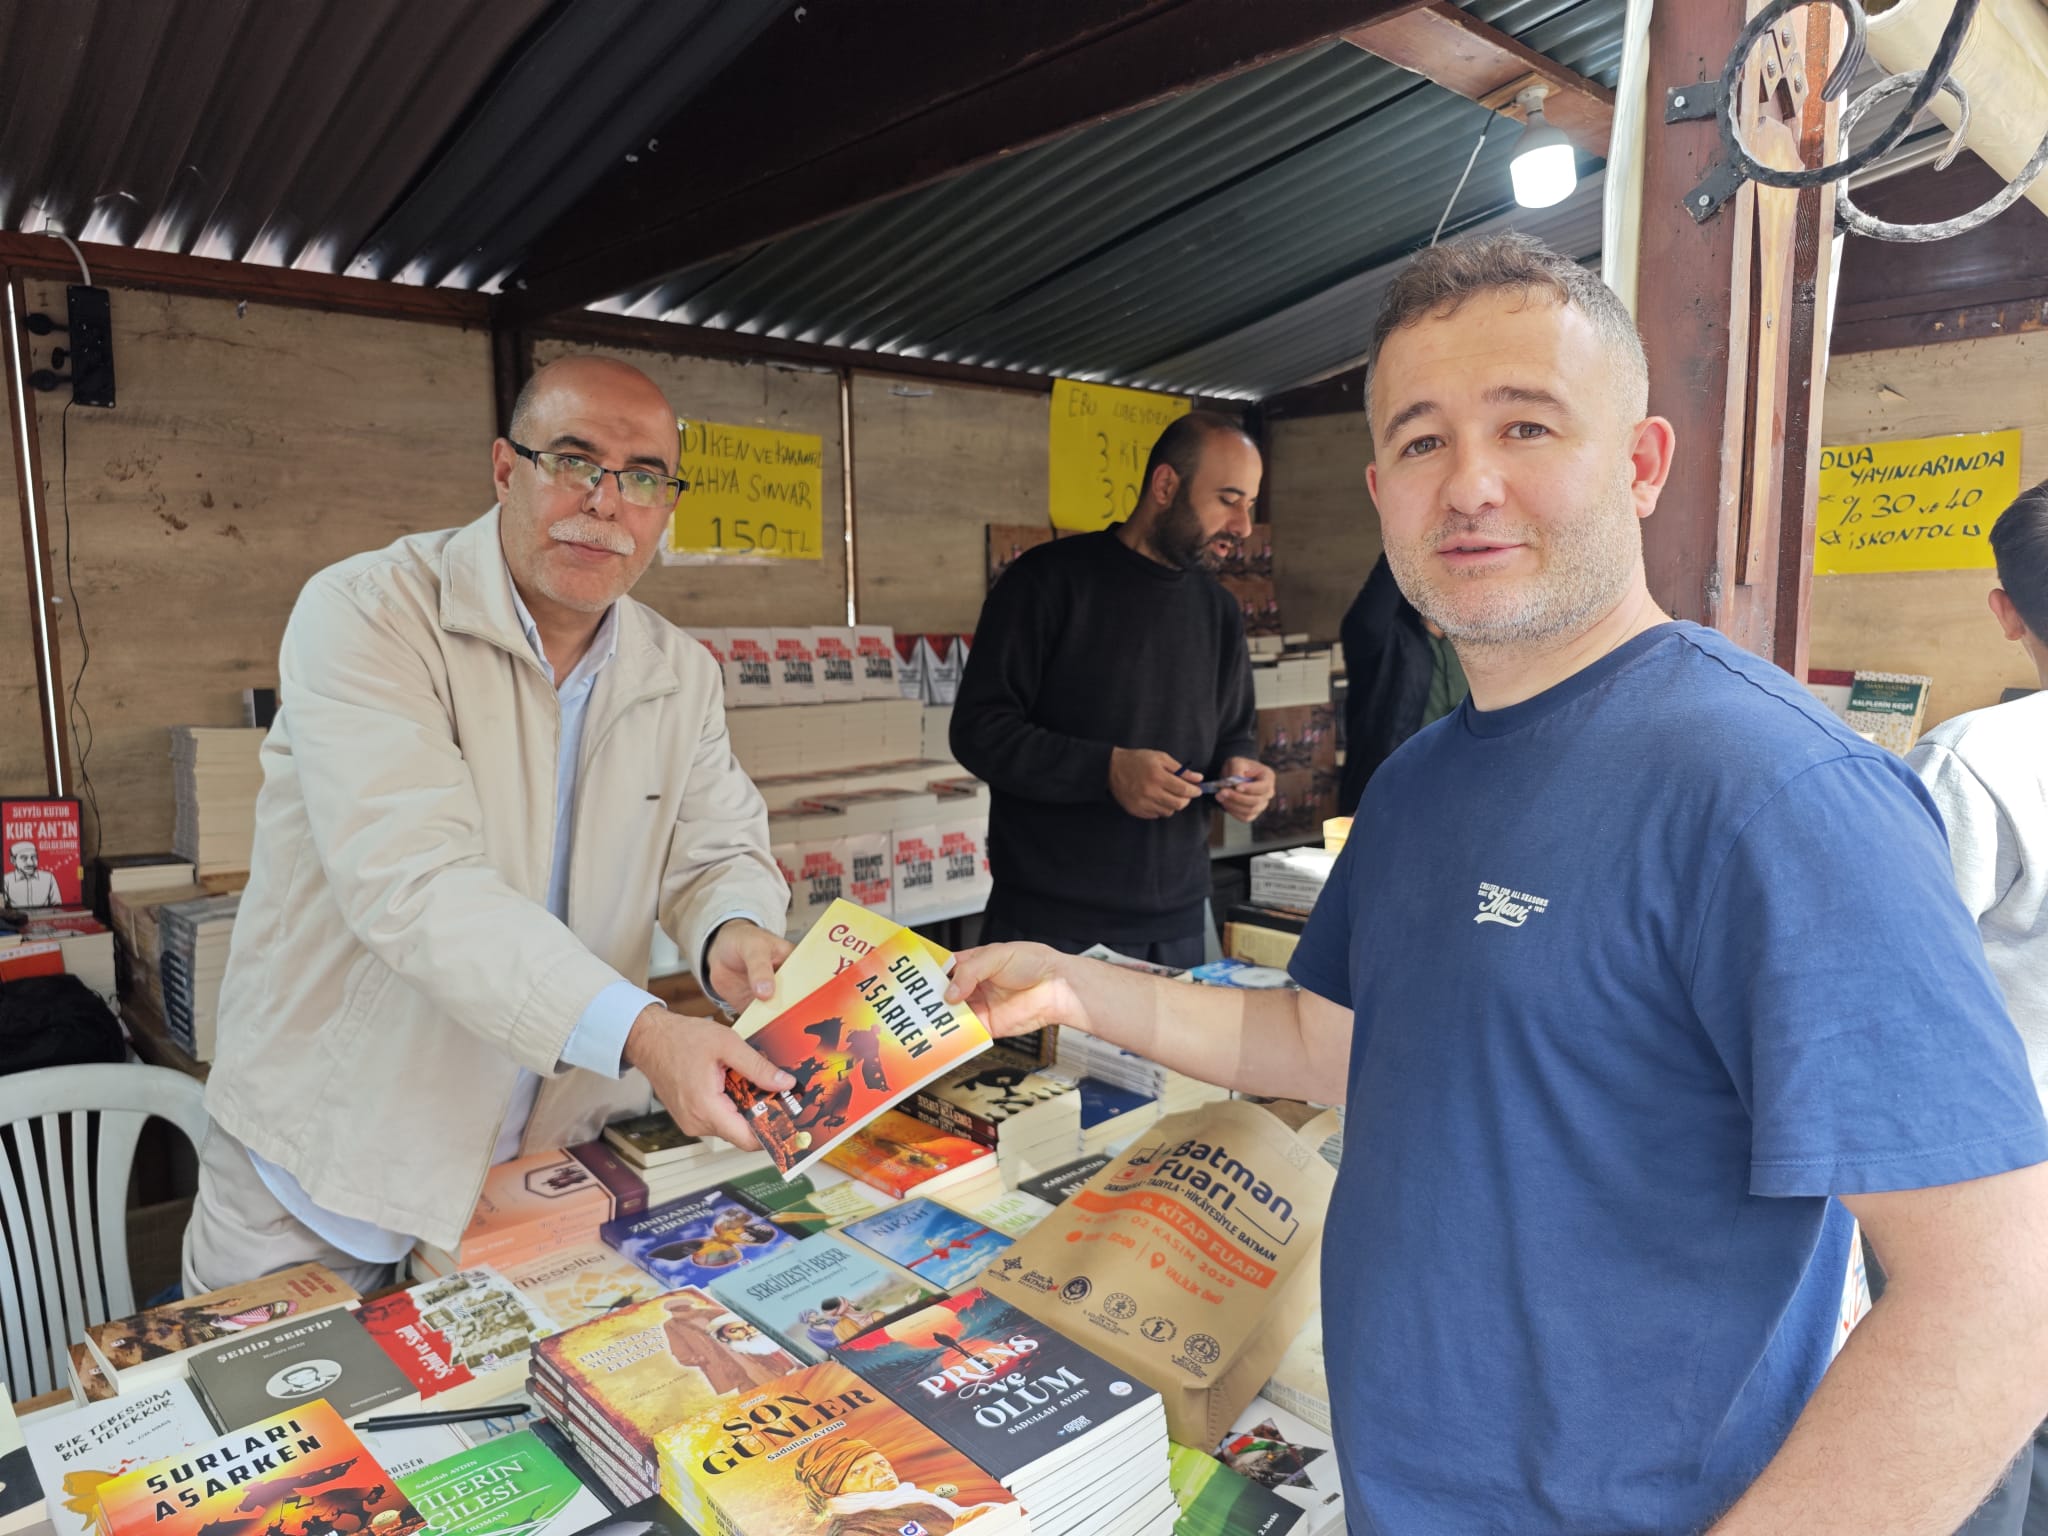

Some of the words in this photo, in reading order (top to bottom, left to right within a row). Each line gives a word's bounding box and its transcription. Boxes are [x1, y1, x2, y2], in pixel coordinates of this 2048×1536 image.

[1097, 431, 1109, 473] 3
[1850, 450, 2005, 487] YAYINLARINDA
[1872, 494, 1916, 518] 30
[1944, 487, 1983, 511] 40
[6, 820, 78, 840] KUR'AN'IN
[888, 955, 960, 1037] SURLARI
[1172, 1139, 1293, 1223] Batman
[1151, 1225, 1198, 1263] KASIM
[1198, 1261, 1236, 1288] 2025
[1157, 1199, 1209, 1243] KİTAP
[1208, 1241, 1265, 1281] FUARI
[1237, 1231, 1277, 1262] BATMAN
[917, 1334, 1039, 1399] PRENS
[723, 1390, 812, 1437] SON
[973, 1366, 1085, 1428] ÖLÜM
[1008, 1405, 1058, 1435] SADULLAH
[1059, 1388, 1090, 1408] AYDIN
[146, 1419, 302, 1495] SURLARI
[766, 1435, 812, 1461] Sadullah
[813, 1420, 846, 1439] AYDIN
